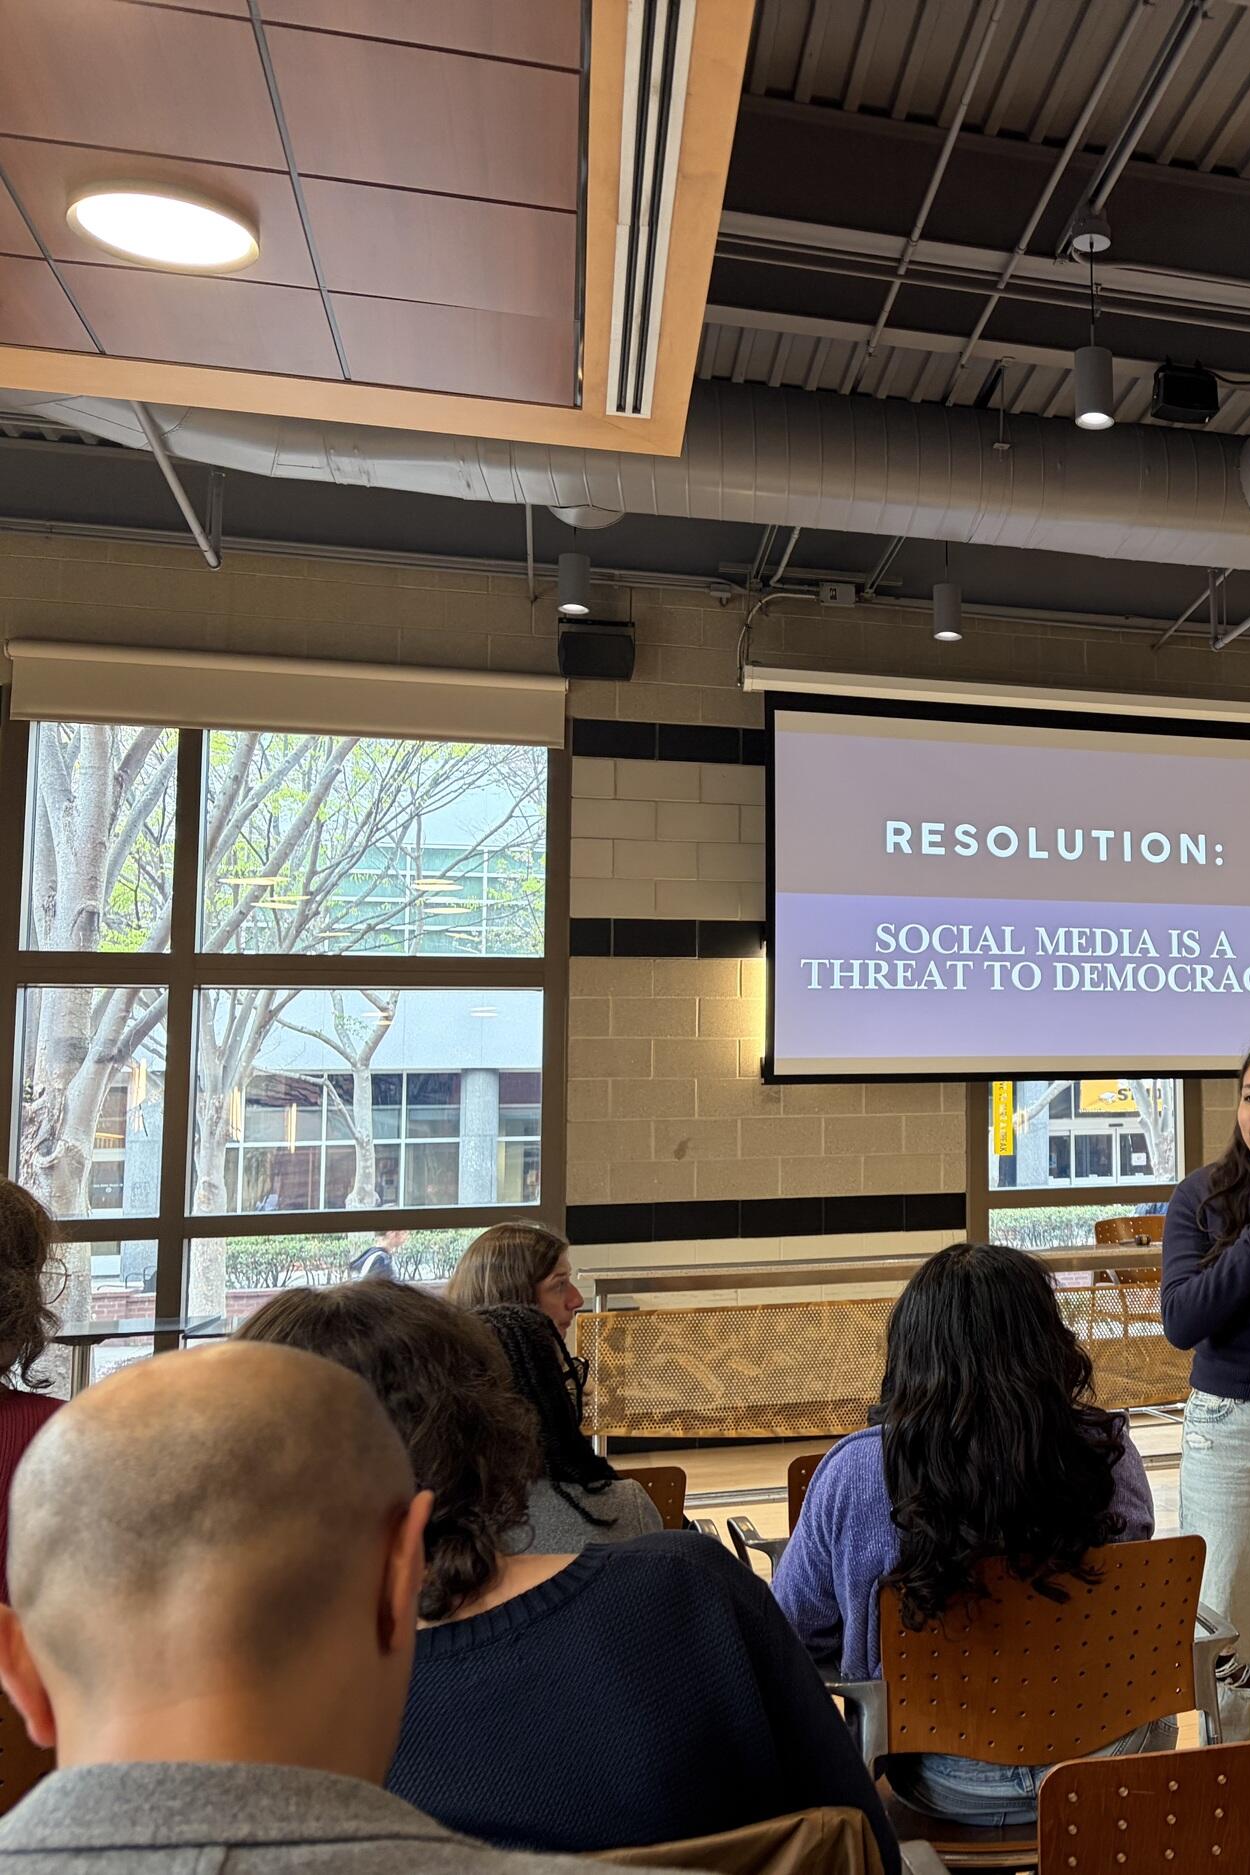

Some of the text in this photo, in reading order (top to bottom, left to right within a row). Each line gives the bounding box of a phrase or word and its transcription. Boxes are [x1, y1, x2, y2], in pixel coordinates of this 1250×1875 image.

[886, 820, 1225, 867] RESOLUTION:
[875, 923, 1237, 960] SOCIAL MEDIA IS A
[800, 958, 974, 990] THREAT
[983, 961, 1043, 992] TO
